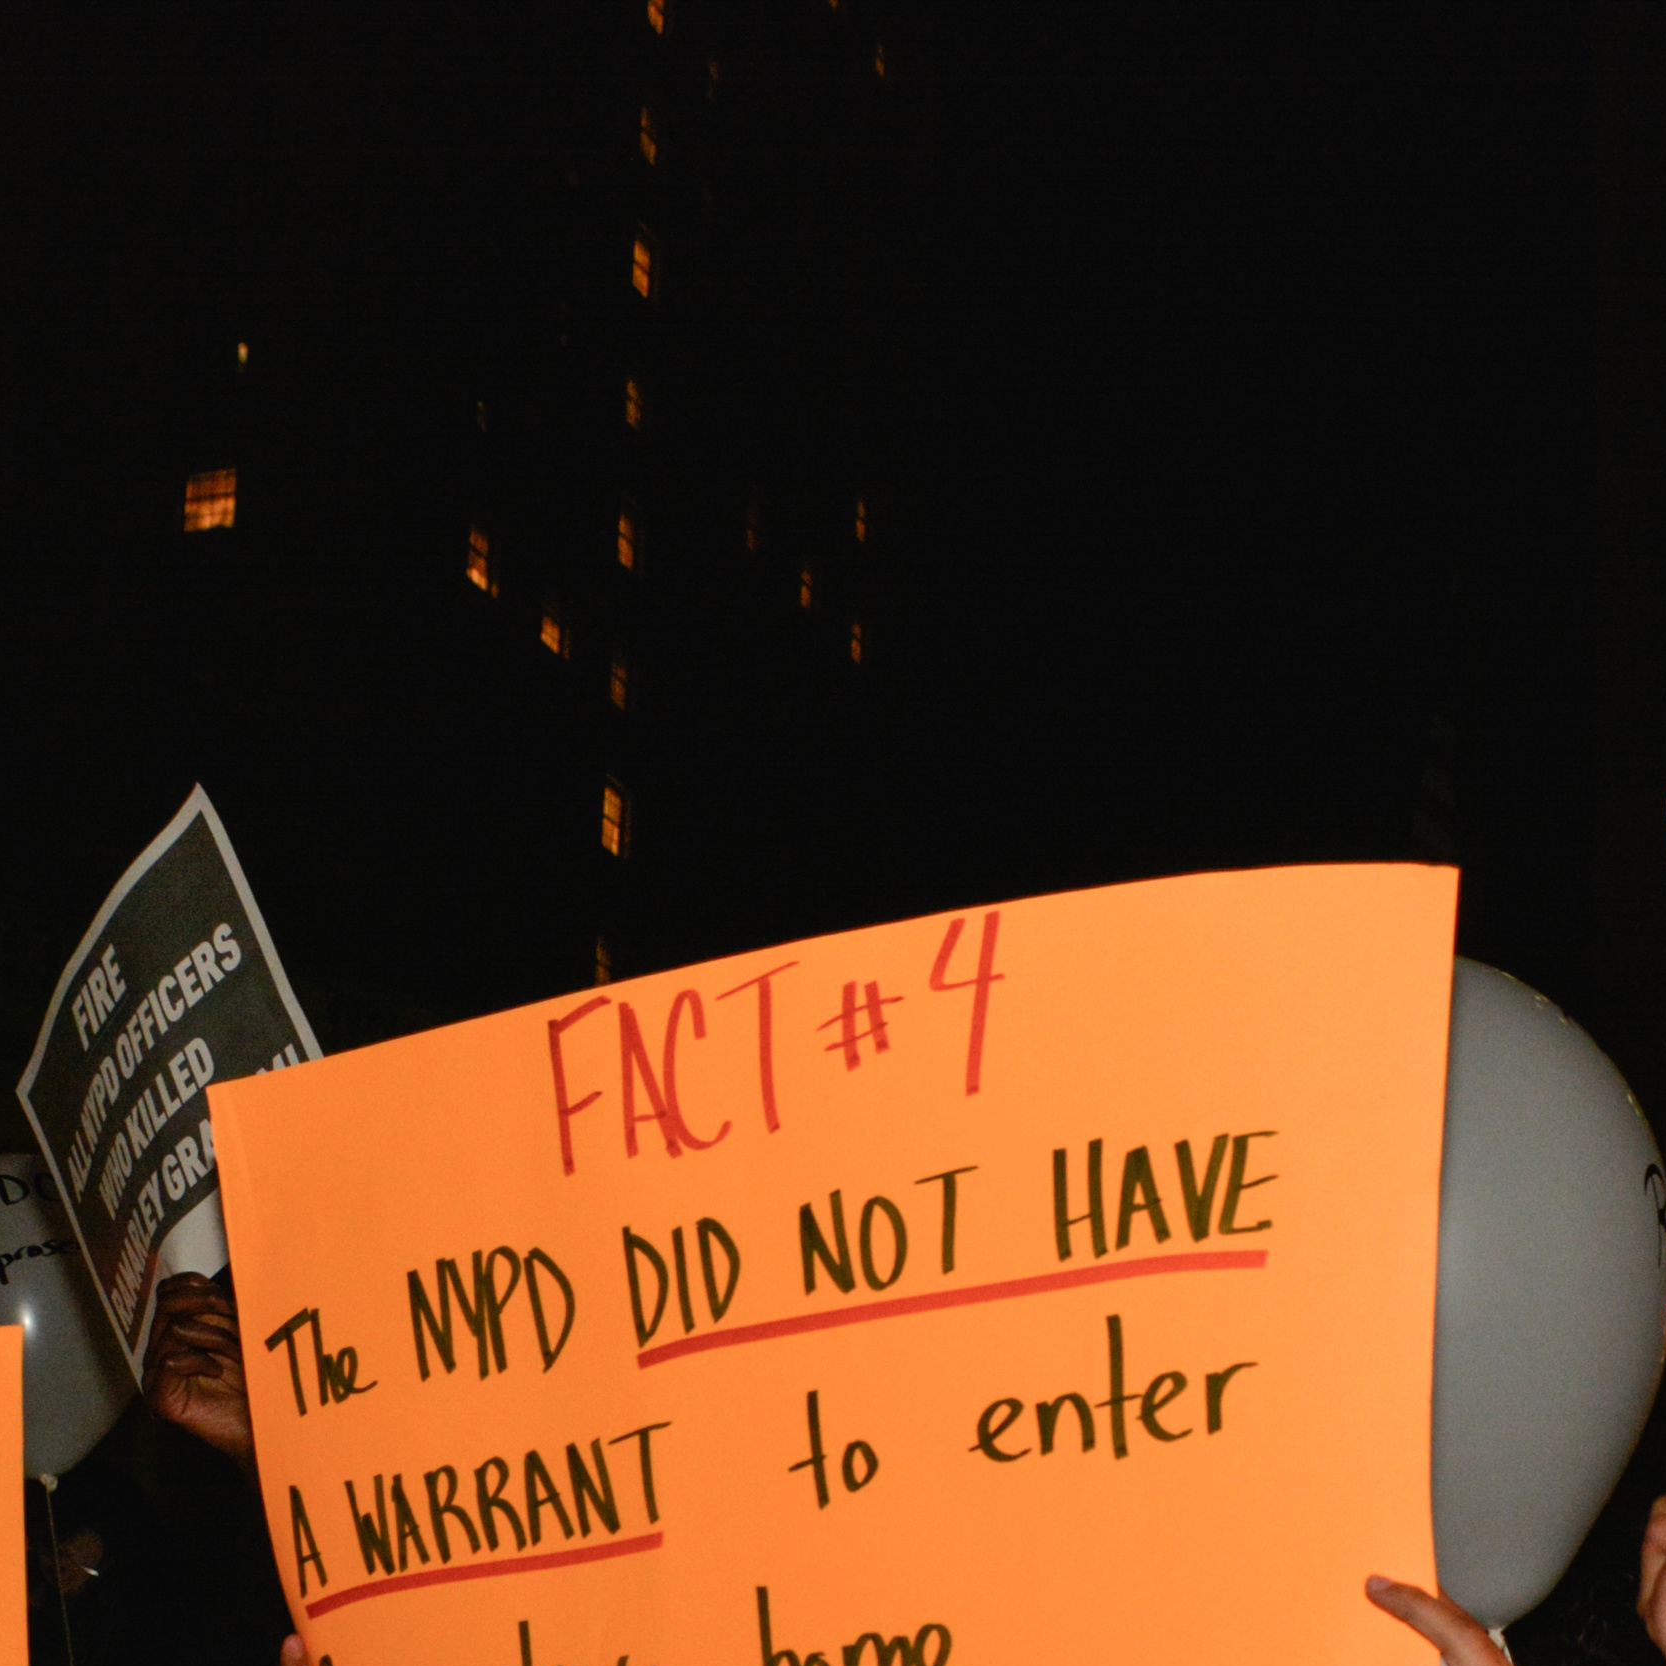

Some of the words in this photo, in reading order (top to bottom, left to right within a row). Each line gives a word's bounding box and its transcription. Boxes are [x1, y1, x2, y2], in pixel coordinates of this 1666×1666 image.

[71, 944, 128, 1052] FIRE
[79, 1056, 120, 1157] NYPD
[116, 922, 243, 1080] OFFICERS
[98, 1127, 133, 1220] WHO
[129, 1036, 217, 1150] KILLED
[264, 1307, 378, 1416] The
[405, 1243, 577, 1383] NYPD
[623, 1216, 741, 1347] DID
[799, 1164, 980, 1297] NOT
[1052, 1128, 1280, 1261] HAVE
[289, 1483, 329, 1598] A
[344, 1421, 673, 1579] WARRANT
[787, 1389, 880, 1511] to
[967, 1314, 1259, 1464] enter
